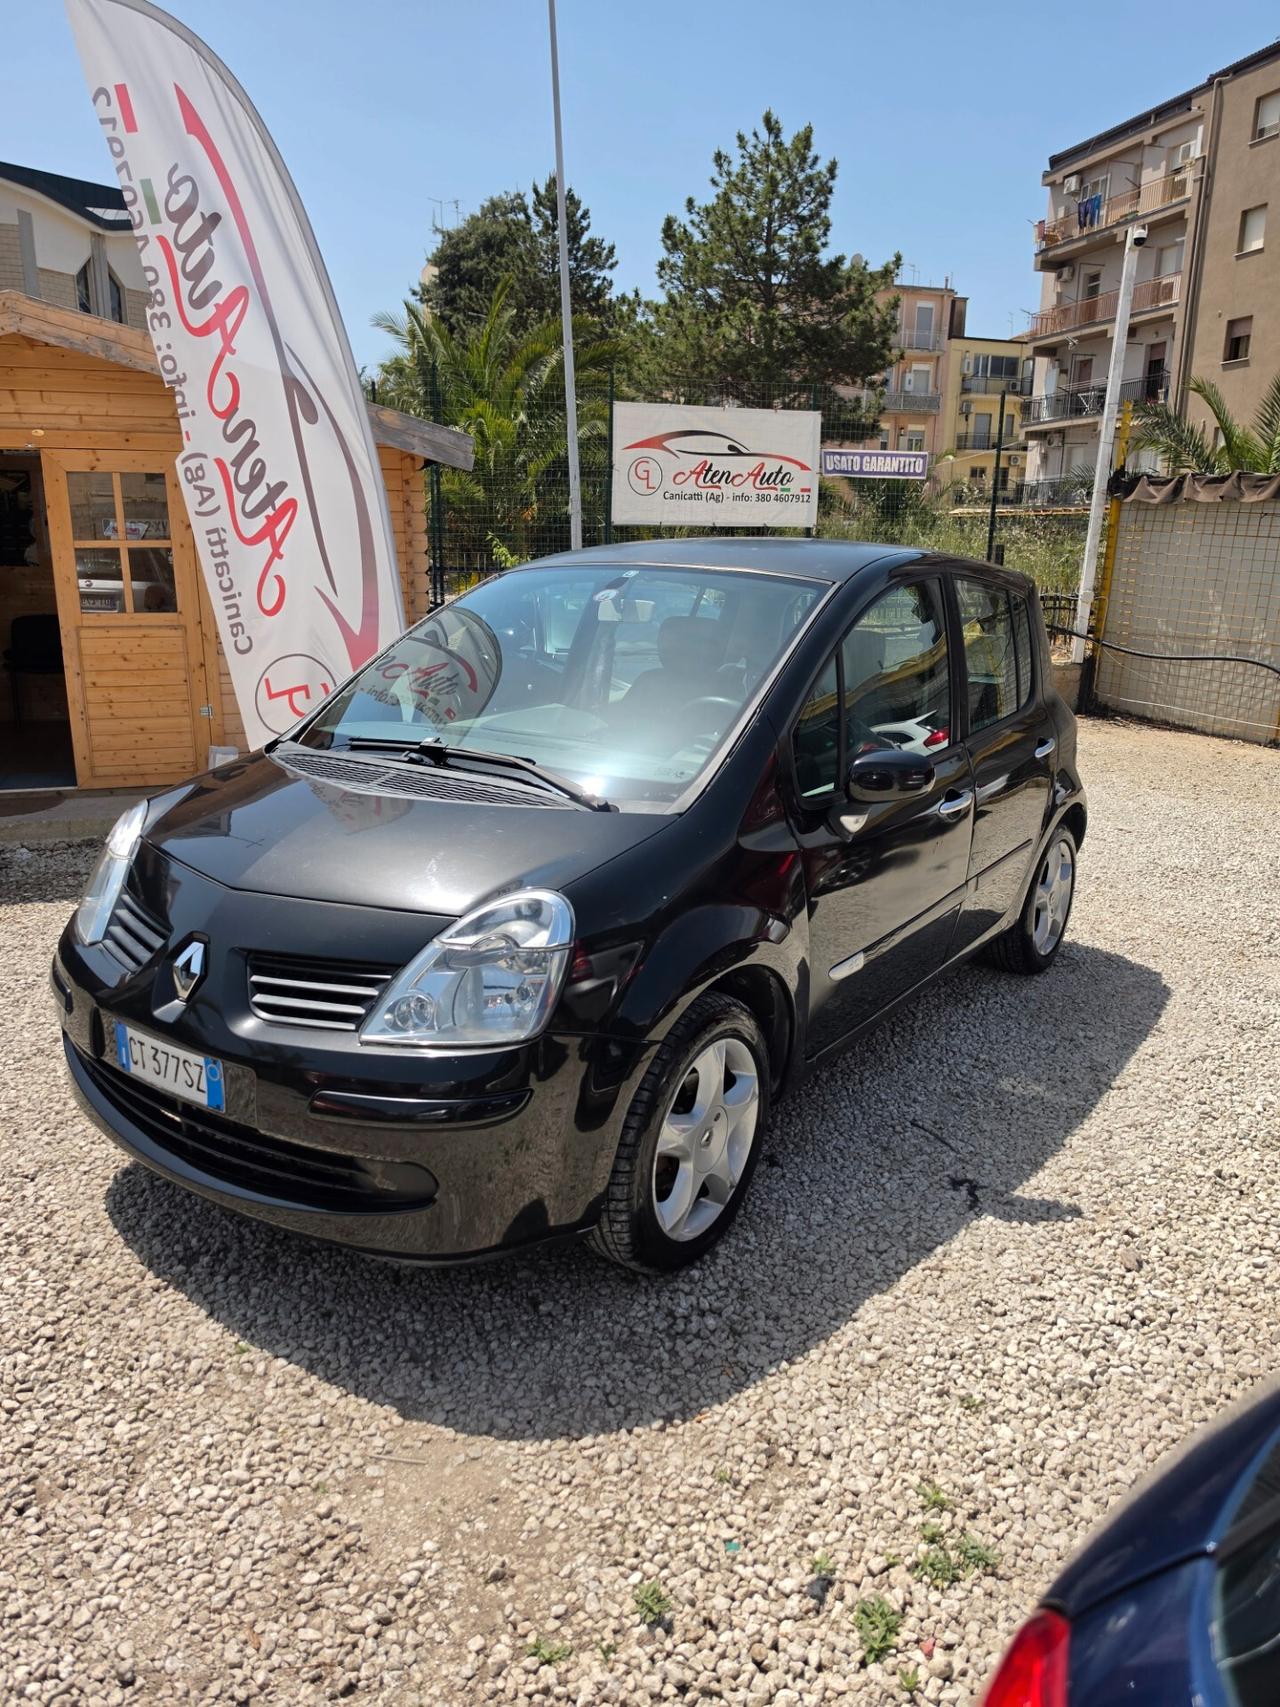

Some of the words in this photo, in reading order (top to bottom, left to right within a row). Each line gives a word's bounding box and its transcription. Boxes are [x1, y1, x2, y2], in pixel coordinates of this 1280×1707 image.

[673, 459, 794, 493] AtenAuto
[825, 455, 861, 473] USATO
[862, 456, 924, 474] GARANTITO
[705, 491, 725, 503] (Ag)
[732, 492, 753, 502] info:
[755, 492, 772, 502] 380
[773, 493, 811, 504] 4607912
[128, 1036, 146, 1069] CT
[150, 1045, 206, 1093] 377SZ
